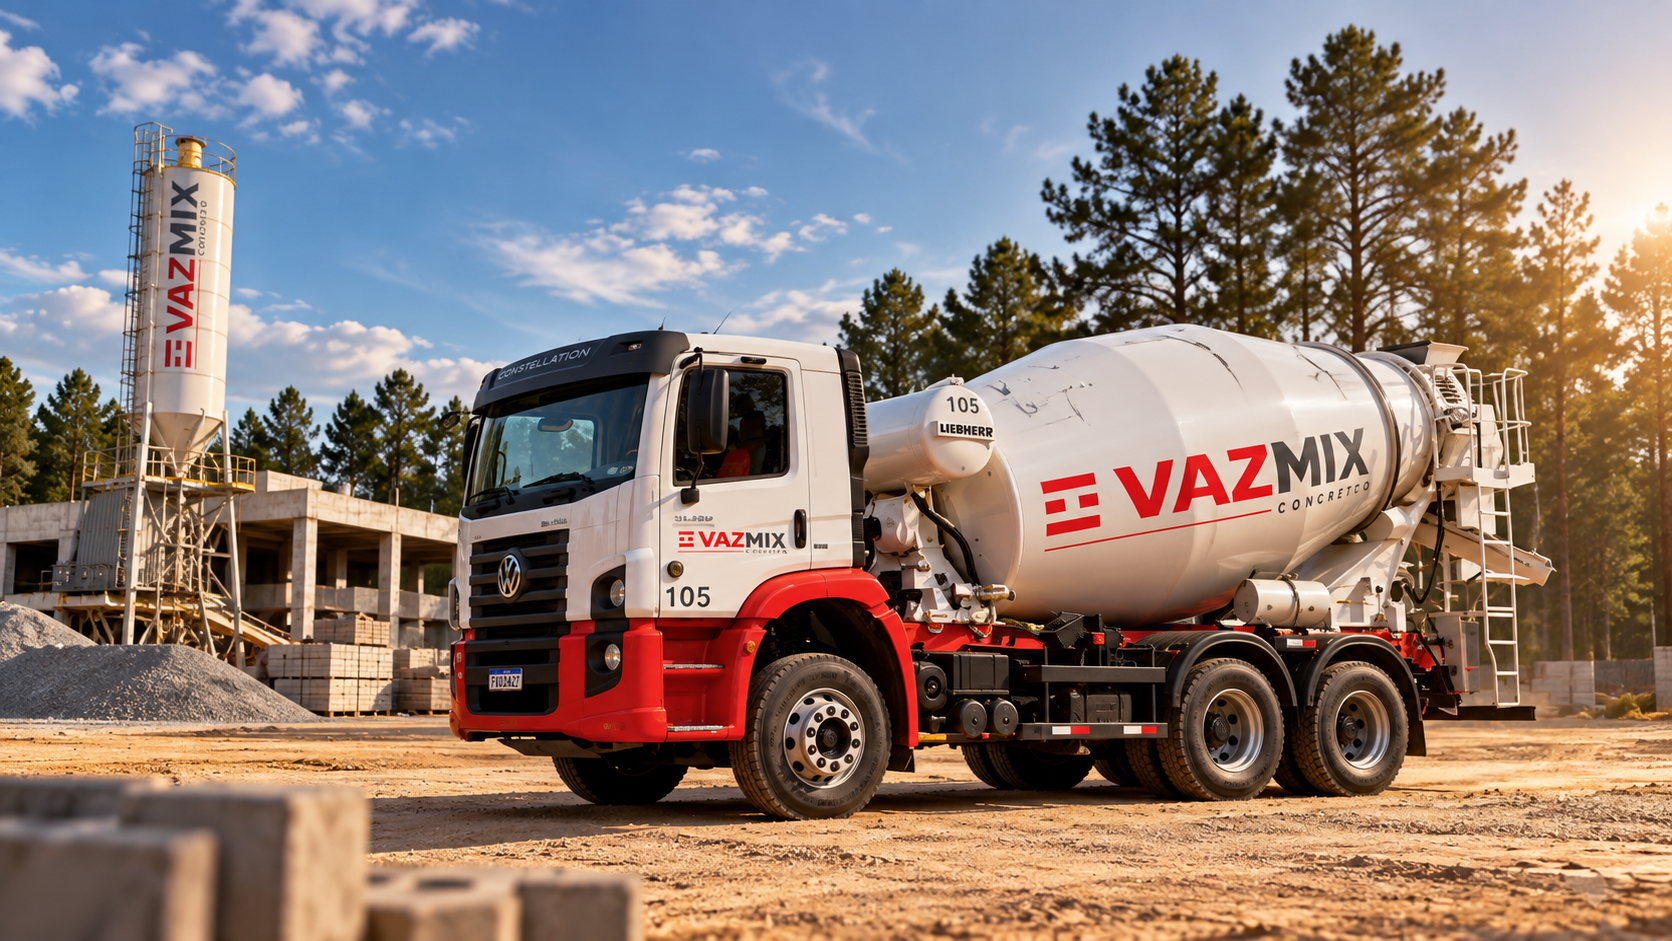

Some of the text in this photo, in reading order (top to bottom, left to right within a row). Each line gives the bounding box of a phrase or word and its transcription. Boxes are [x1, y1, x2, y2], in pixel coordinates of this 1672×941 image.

[166, 180, 199, 334] VAZMIX
[498, 347, 591, 380] CONSTELLATION
[946, 396, 979, 414] 105
[940, 423, 994, 438] LIEBHERR
[1113, 427, 1369, 519] VAZMIX
[698, 531, 786, 548] VAZMIX
[666, 586, 711, 607] 105
